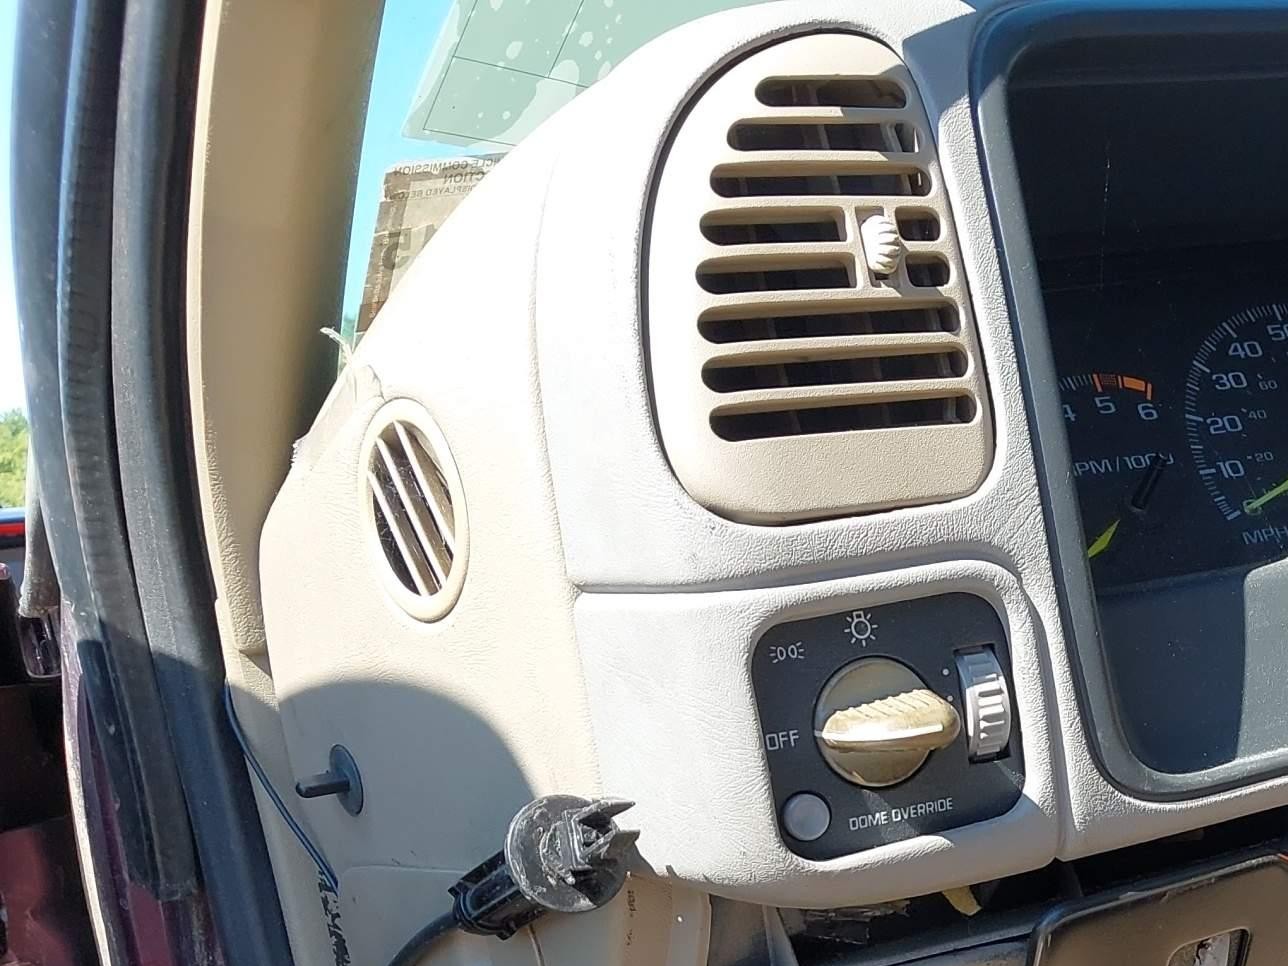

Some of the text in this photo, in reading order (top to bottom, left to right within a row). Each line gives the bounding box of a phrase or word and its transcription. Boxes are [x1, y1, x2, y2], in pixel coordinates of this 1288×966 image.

[1227, 341, 1263, 358] 40
[1211, 372, 1247, 390] 30
[1258, 380, 1278, 390] 60
[1062, 404, 1078, 422] 4
[1093, 396, 1117, 414] 5
[1137, 403, 1158, 421] 6
[1247, 409, 1267, 420] 40
[1206, 415, 1243, 434] 20
[1072, 452, 1174, 477] PM/10
[1254, 451, 1274, 462] 20
[1216, 460, 1245, 478] 10
[765, 729, 799, 750] OFF
[849, 797, 953, 830] DOME OVERRIDE
